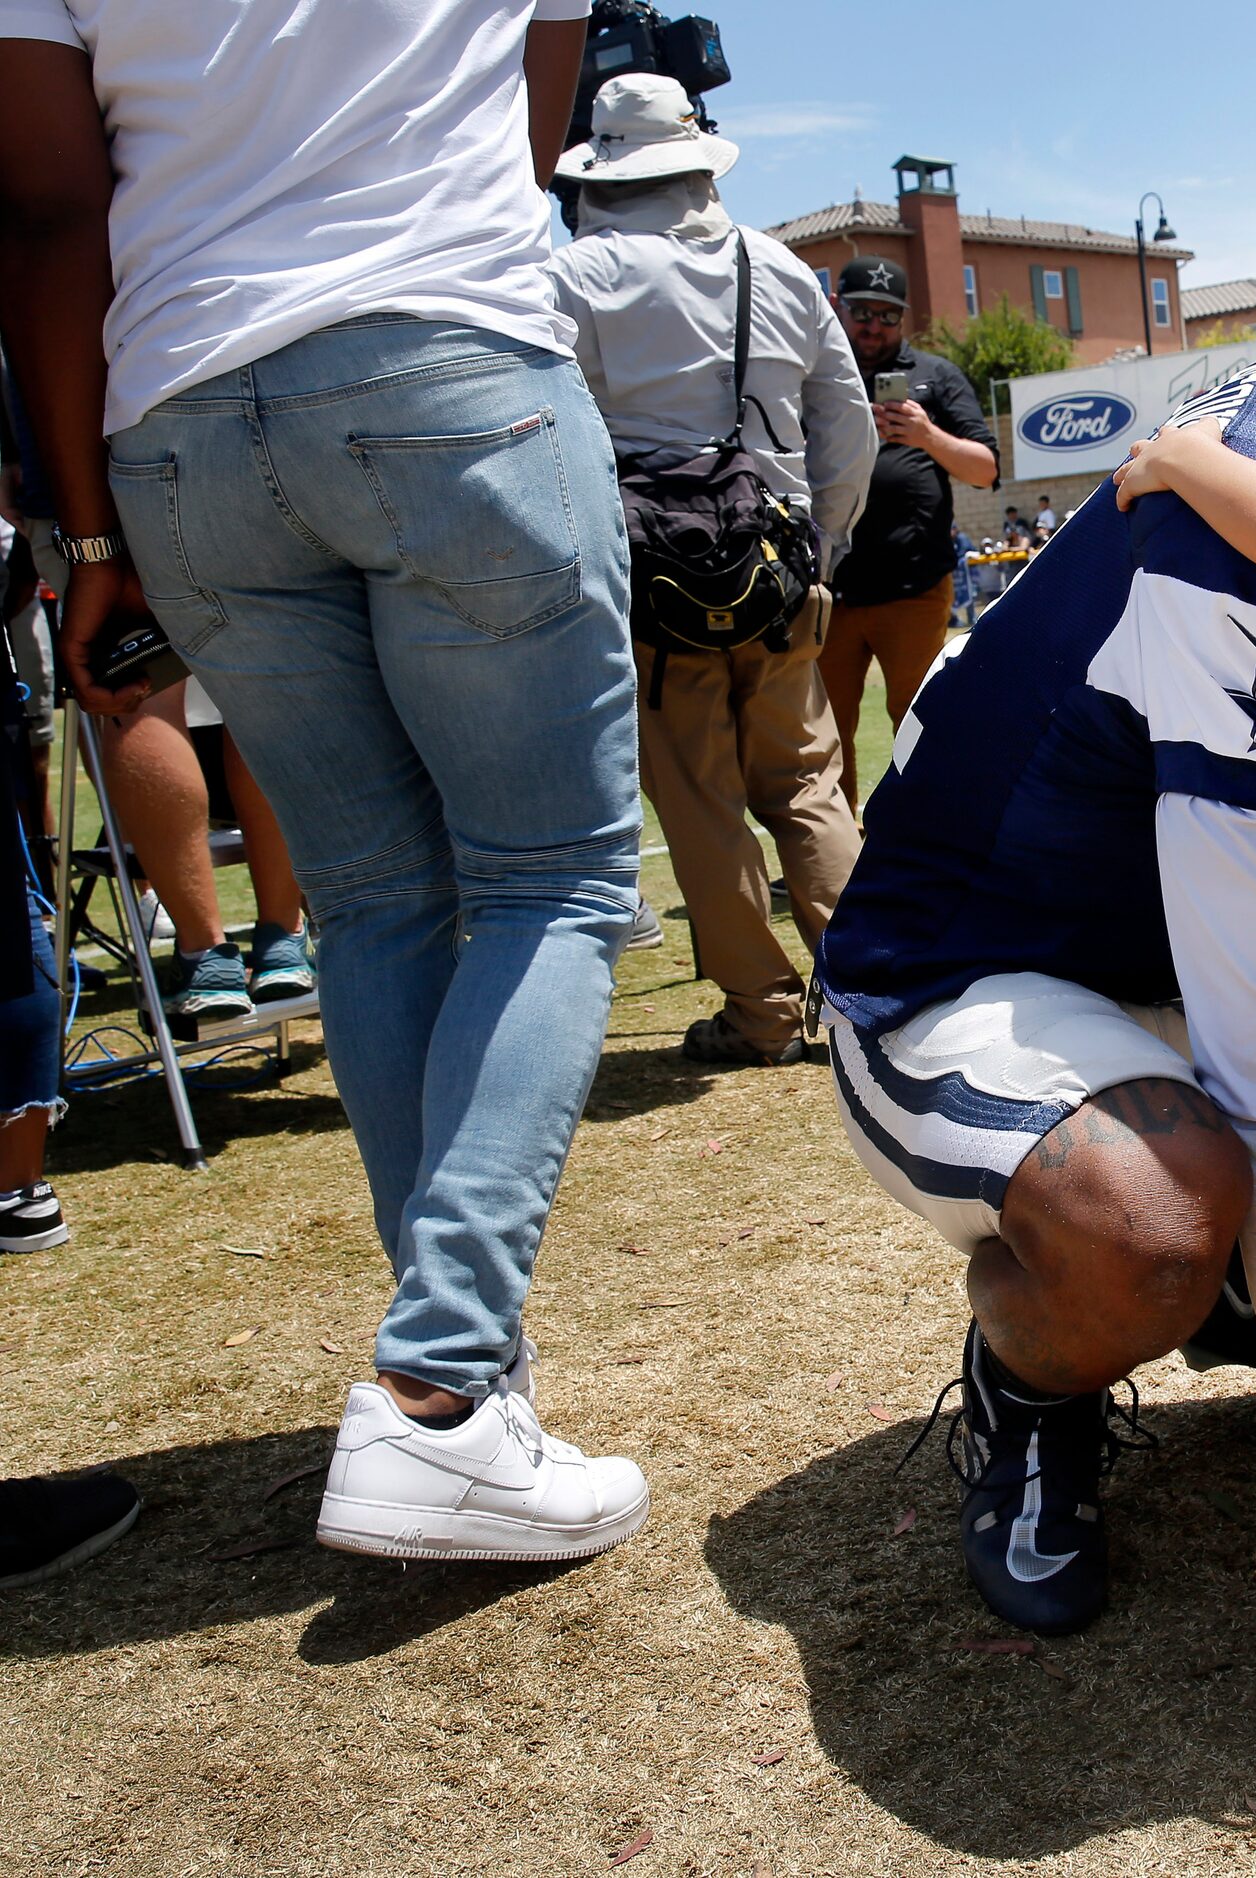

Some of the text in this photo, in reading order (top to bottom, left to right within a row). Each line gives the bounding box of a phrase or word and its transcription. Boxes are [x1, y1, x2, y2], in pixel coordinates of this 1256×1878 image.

[1040, 400, 1112, 444] Ford
[33, 1182, 52, 1198] NIKE
[394, 1525, 422, 1548] AIR
